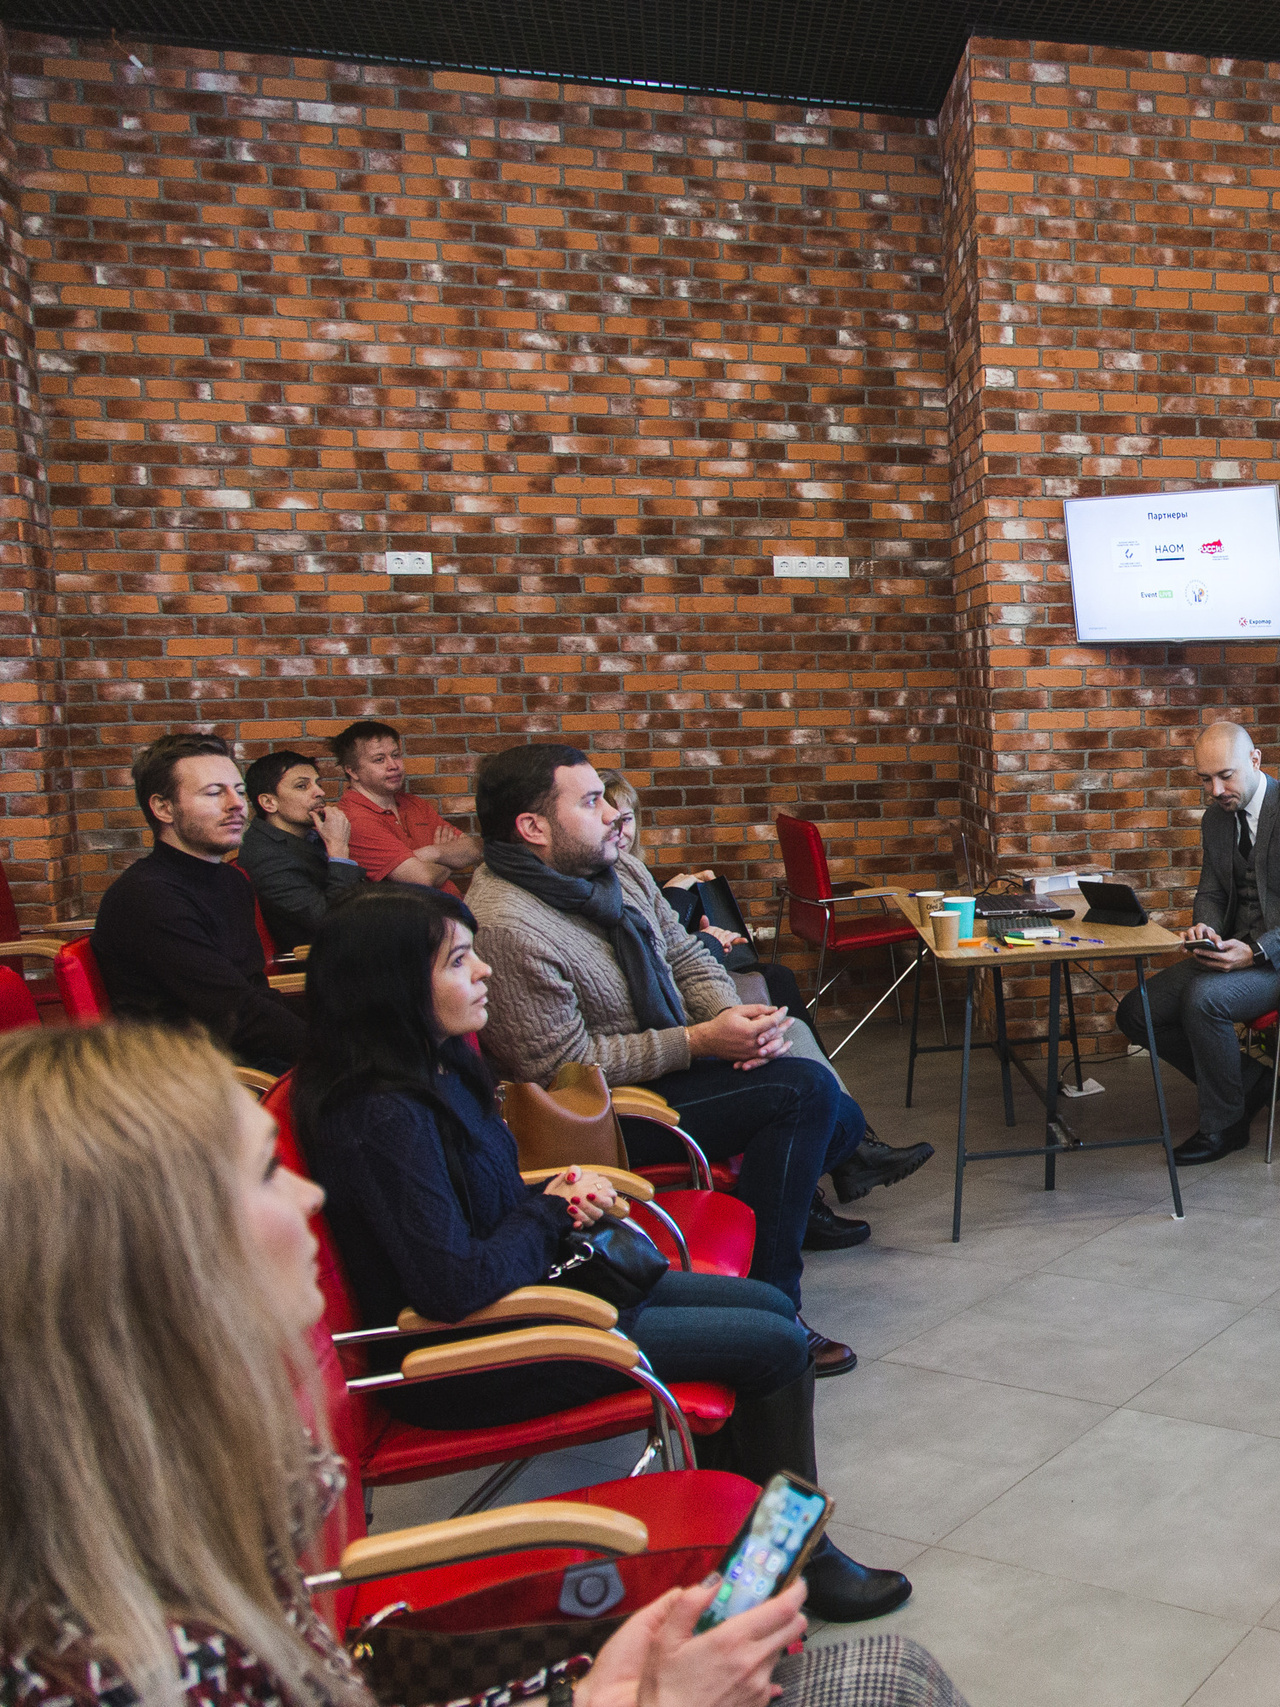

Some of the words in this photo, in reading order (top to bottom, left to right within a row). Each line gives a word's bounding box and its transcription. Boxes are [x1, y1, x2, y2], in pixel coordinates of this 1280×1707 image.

[1147, 511, 1188, 521] Партнеры
[1154, 544, 1185, 554] НАОМ
[1140, 591, 1157, 599] Event
